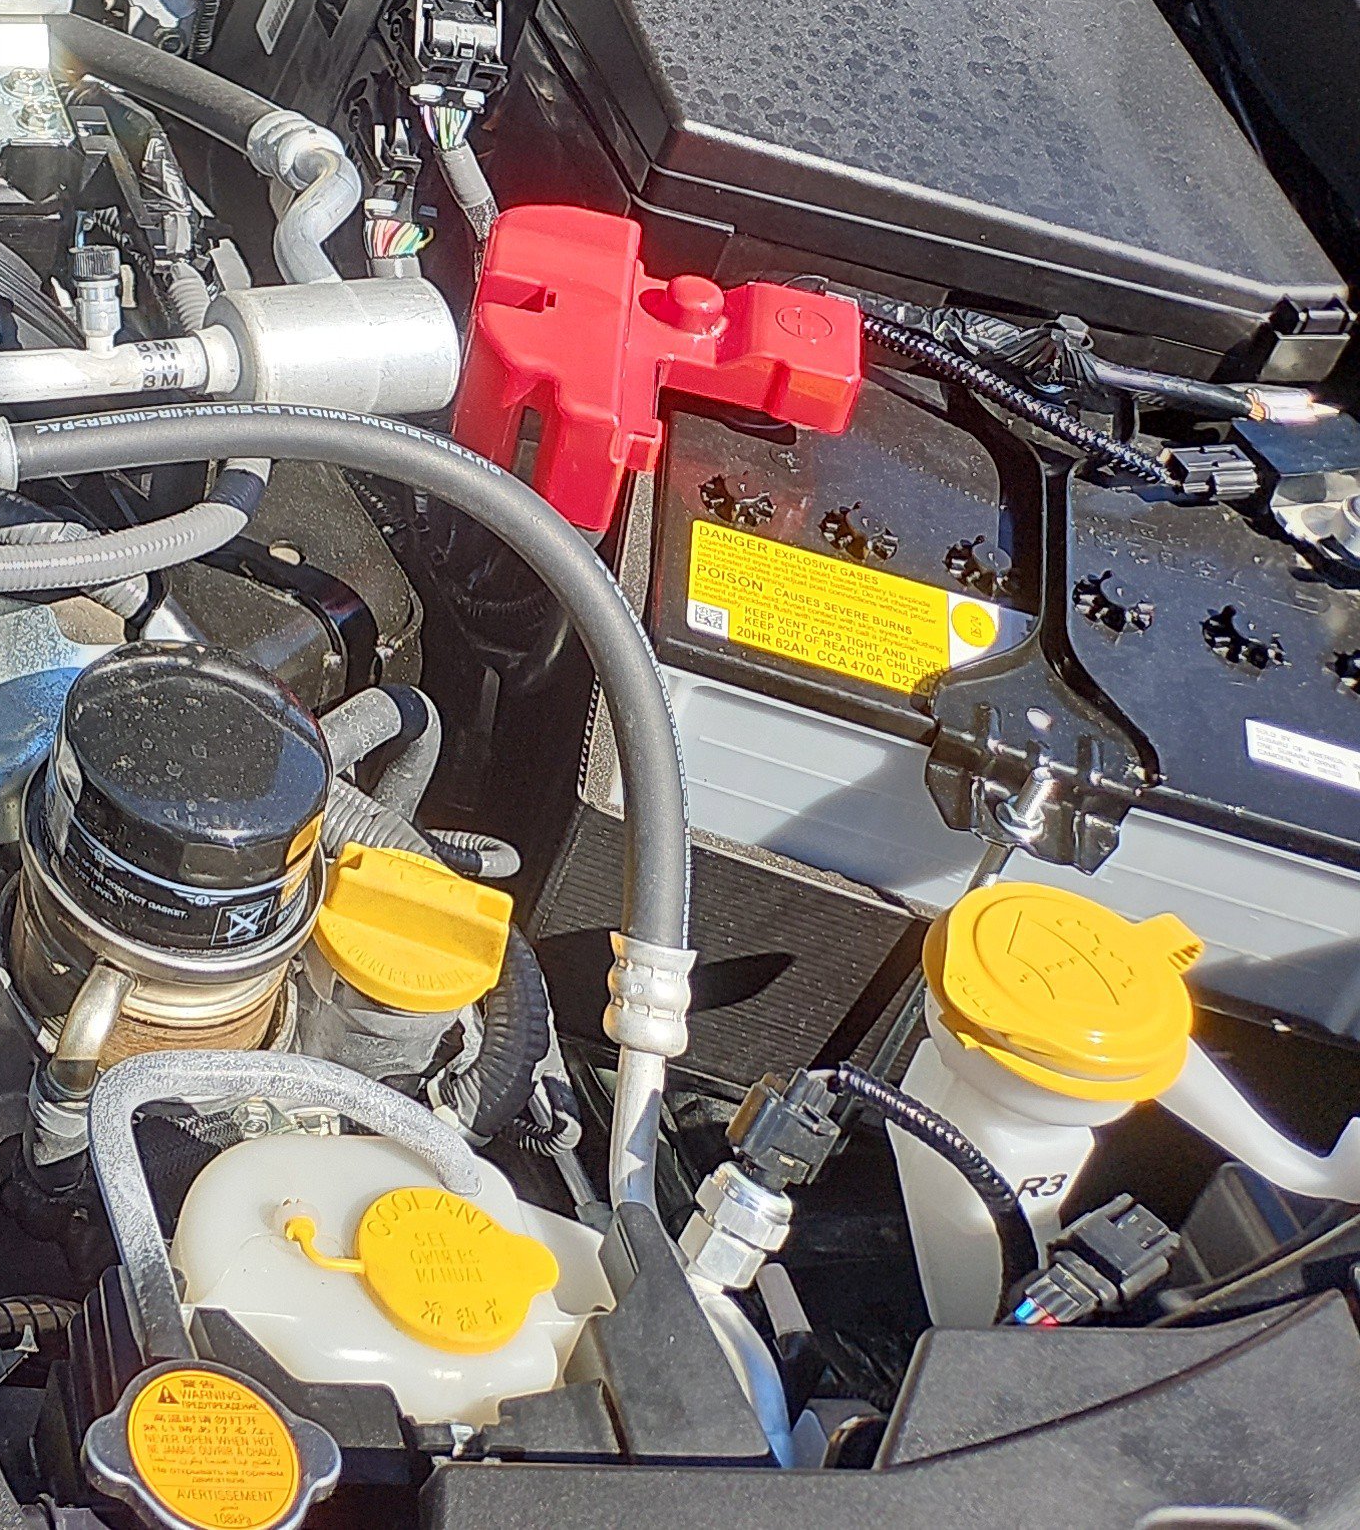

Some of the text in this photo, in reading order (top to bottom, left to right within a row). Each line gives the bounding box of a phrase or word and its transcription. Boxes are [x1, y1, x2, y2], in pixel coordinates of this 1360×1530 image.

[698, 524, 879, 585] DANGER EXPLOSIVE GASES
[697, 563, 912, 635] POISON CAUSES SEVERE BURNS
[736, 625, 770, 645] 20HR
[775, 636, 808, 657] 62Ah
[816, 648, 846, 668] CCA
[849, 659, 884, 679] 470A
[744, 605, 774, 622] KEEP
[777, 615, 807, 632] VENT
[810, 624, 841, 642] CAPS
[846, 635, 880, 653] TIGHT
[881, 646, 907, 661] AND
[744, 615, 774, 632] KEEP
[777, 625, 801, 640] OUT
[803, 633, 821, 646] OF
[823, 638, 863, 659] REACH
[866, 652, 882, 664] OF
[1016, 1172, 1070, 1199] R3
[366, 1190, 499, 1237] COOLANT
[179, 1389, 241, 1400] WARNING
[144, 1434, 178, 1444] NEVER
[183, 1434, 212, 1444] OPEN
[217, 1435, 249, 1445] WHEN
[176, 1488, 274, 1502] AVERTISSEMENT
